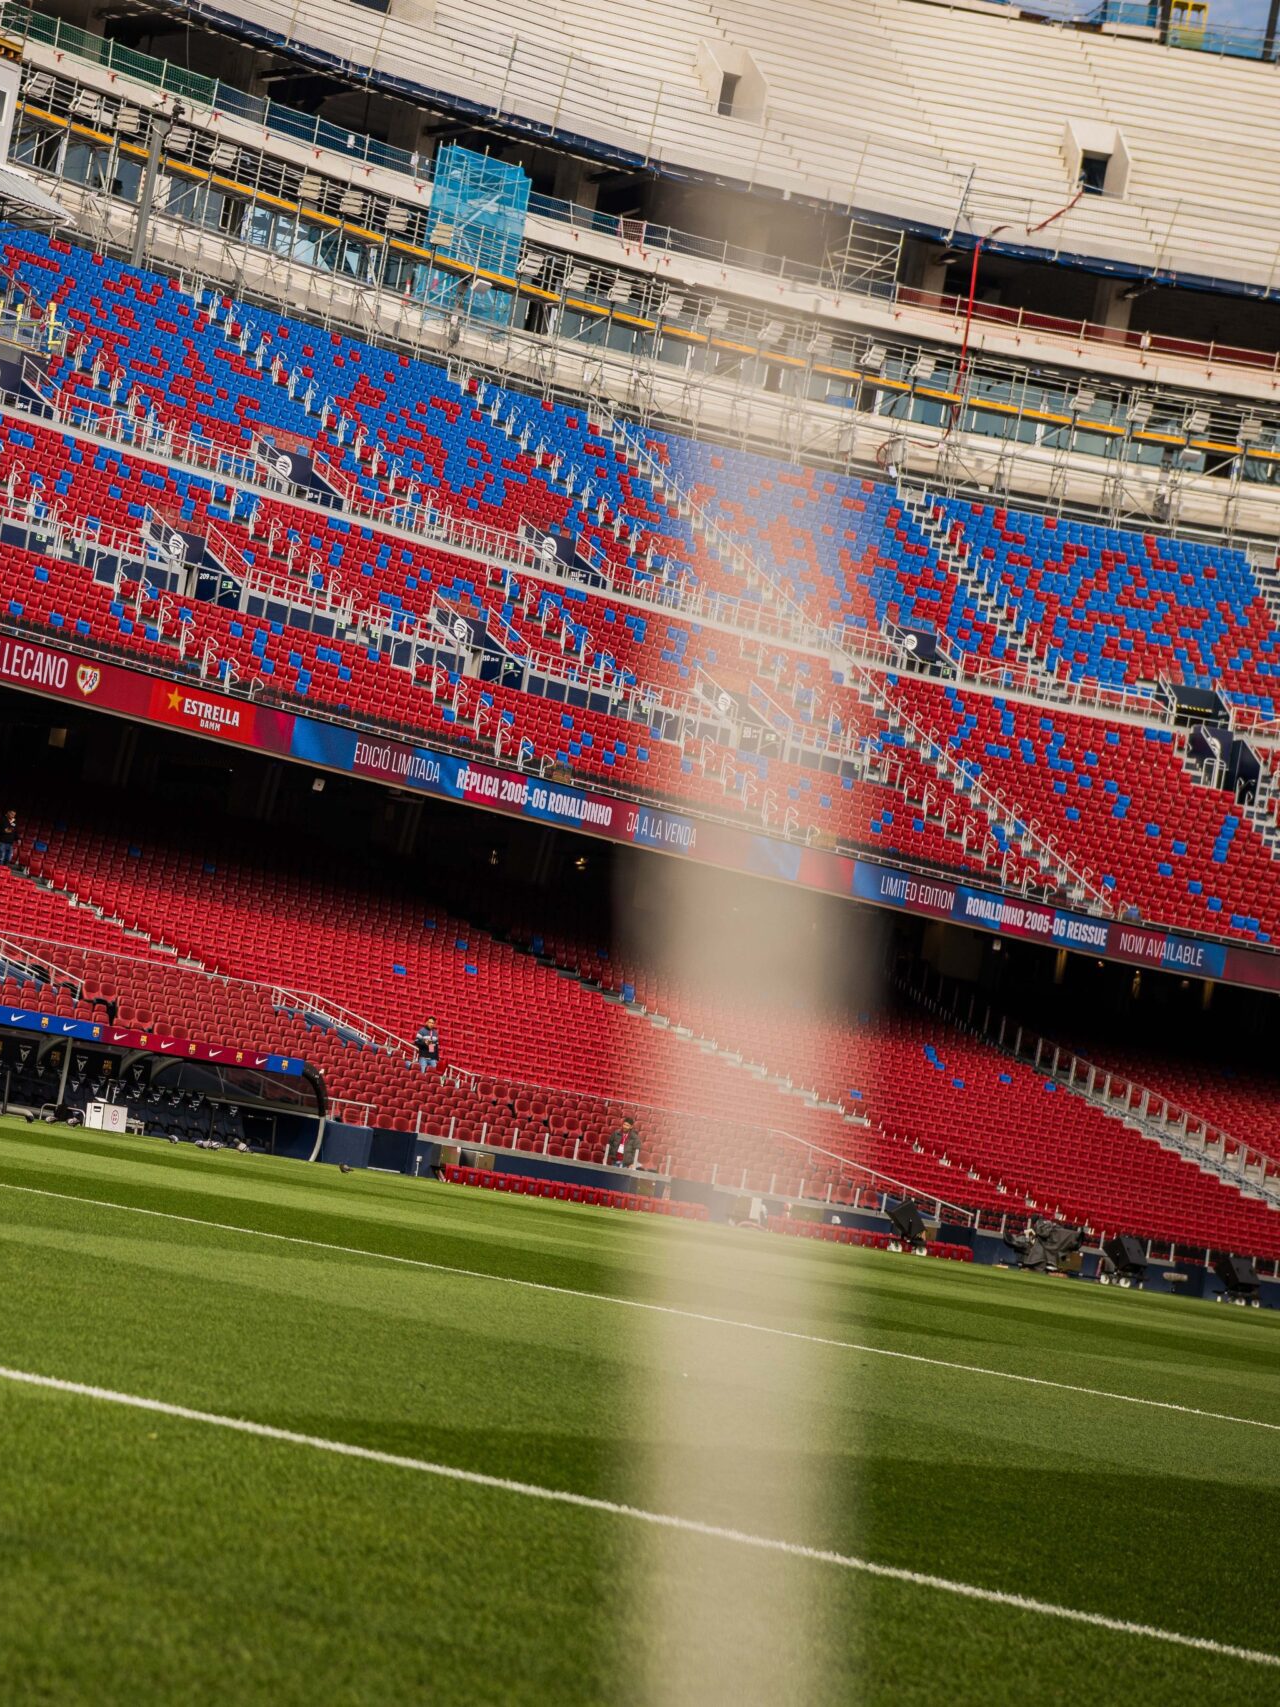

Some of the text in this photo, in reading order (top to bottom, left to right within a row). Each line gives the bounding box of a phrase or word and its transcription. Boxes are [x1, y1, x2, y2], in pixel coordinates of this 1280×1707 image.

[183, 698, 240, 727] ESTRELLA
[200, 719, 221, 732] DAMM
[353, 741, 697, 848] EDICIÓ LIMITADA RÈPLICA 2005-06 RONALDINHO JA A LA VENDA
[880, 875, 1204, 967] LIMITED EDITION RONALDINHO 2005-06 REISSUE NOW AVAILABLE
